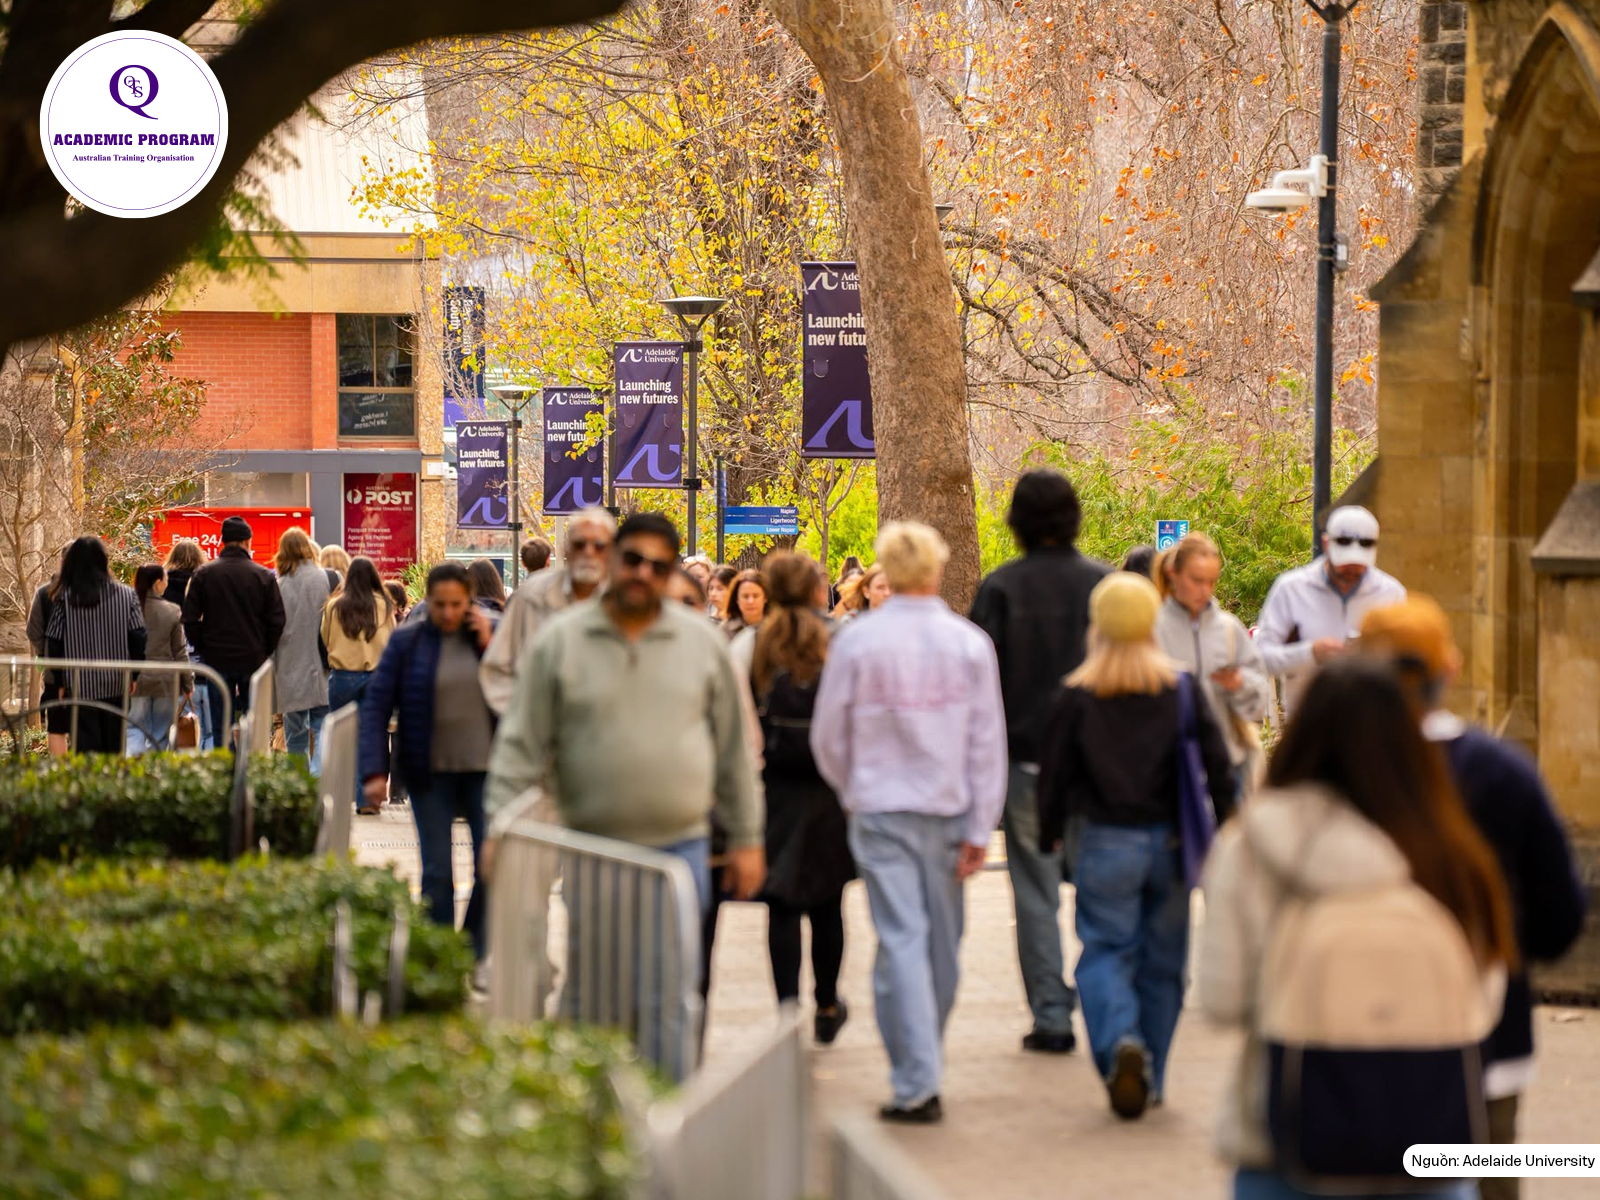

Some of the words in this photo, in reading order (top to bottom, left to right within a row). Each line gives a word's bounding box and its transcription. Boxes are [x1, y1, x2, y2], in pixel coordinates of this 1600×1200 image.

[808, 312, 865, 328] Launchi
[808, 334, 836, 346] new
[838, 330, 867, 346] futu
[644, 348, 676, 356] Adelaide
[644, 355, 680, 364] University
[620, 379, 672, 393] Launching
[620, 395, 640, 404] new
[642, 392, 679, 404] futures
[547, 419, 588, 430] Launchin
[547, 433, 566, 442] new
[567, 430, 594, 442] futu
[460, 448, 500, 459] Launching
[460, 460, 476, 468] new
[477, 458, 505, 468] futures
[365, 491, 413, 505] POST
[201, 533, 223, 547] 24/
